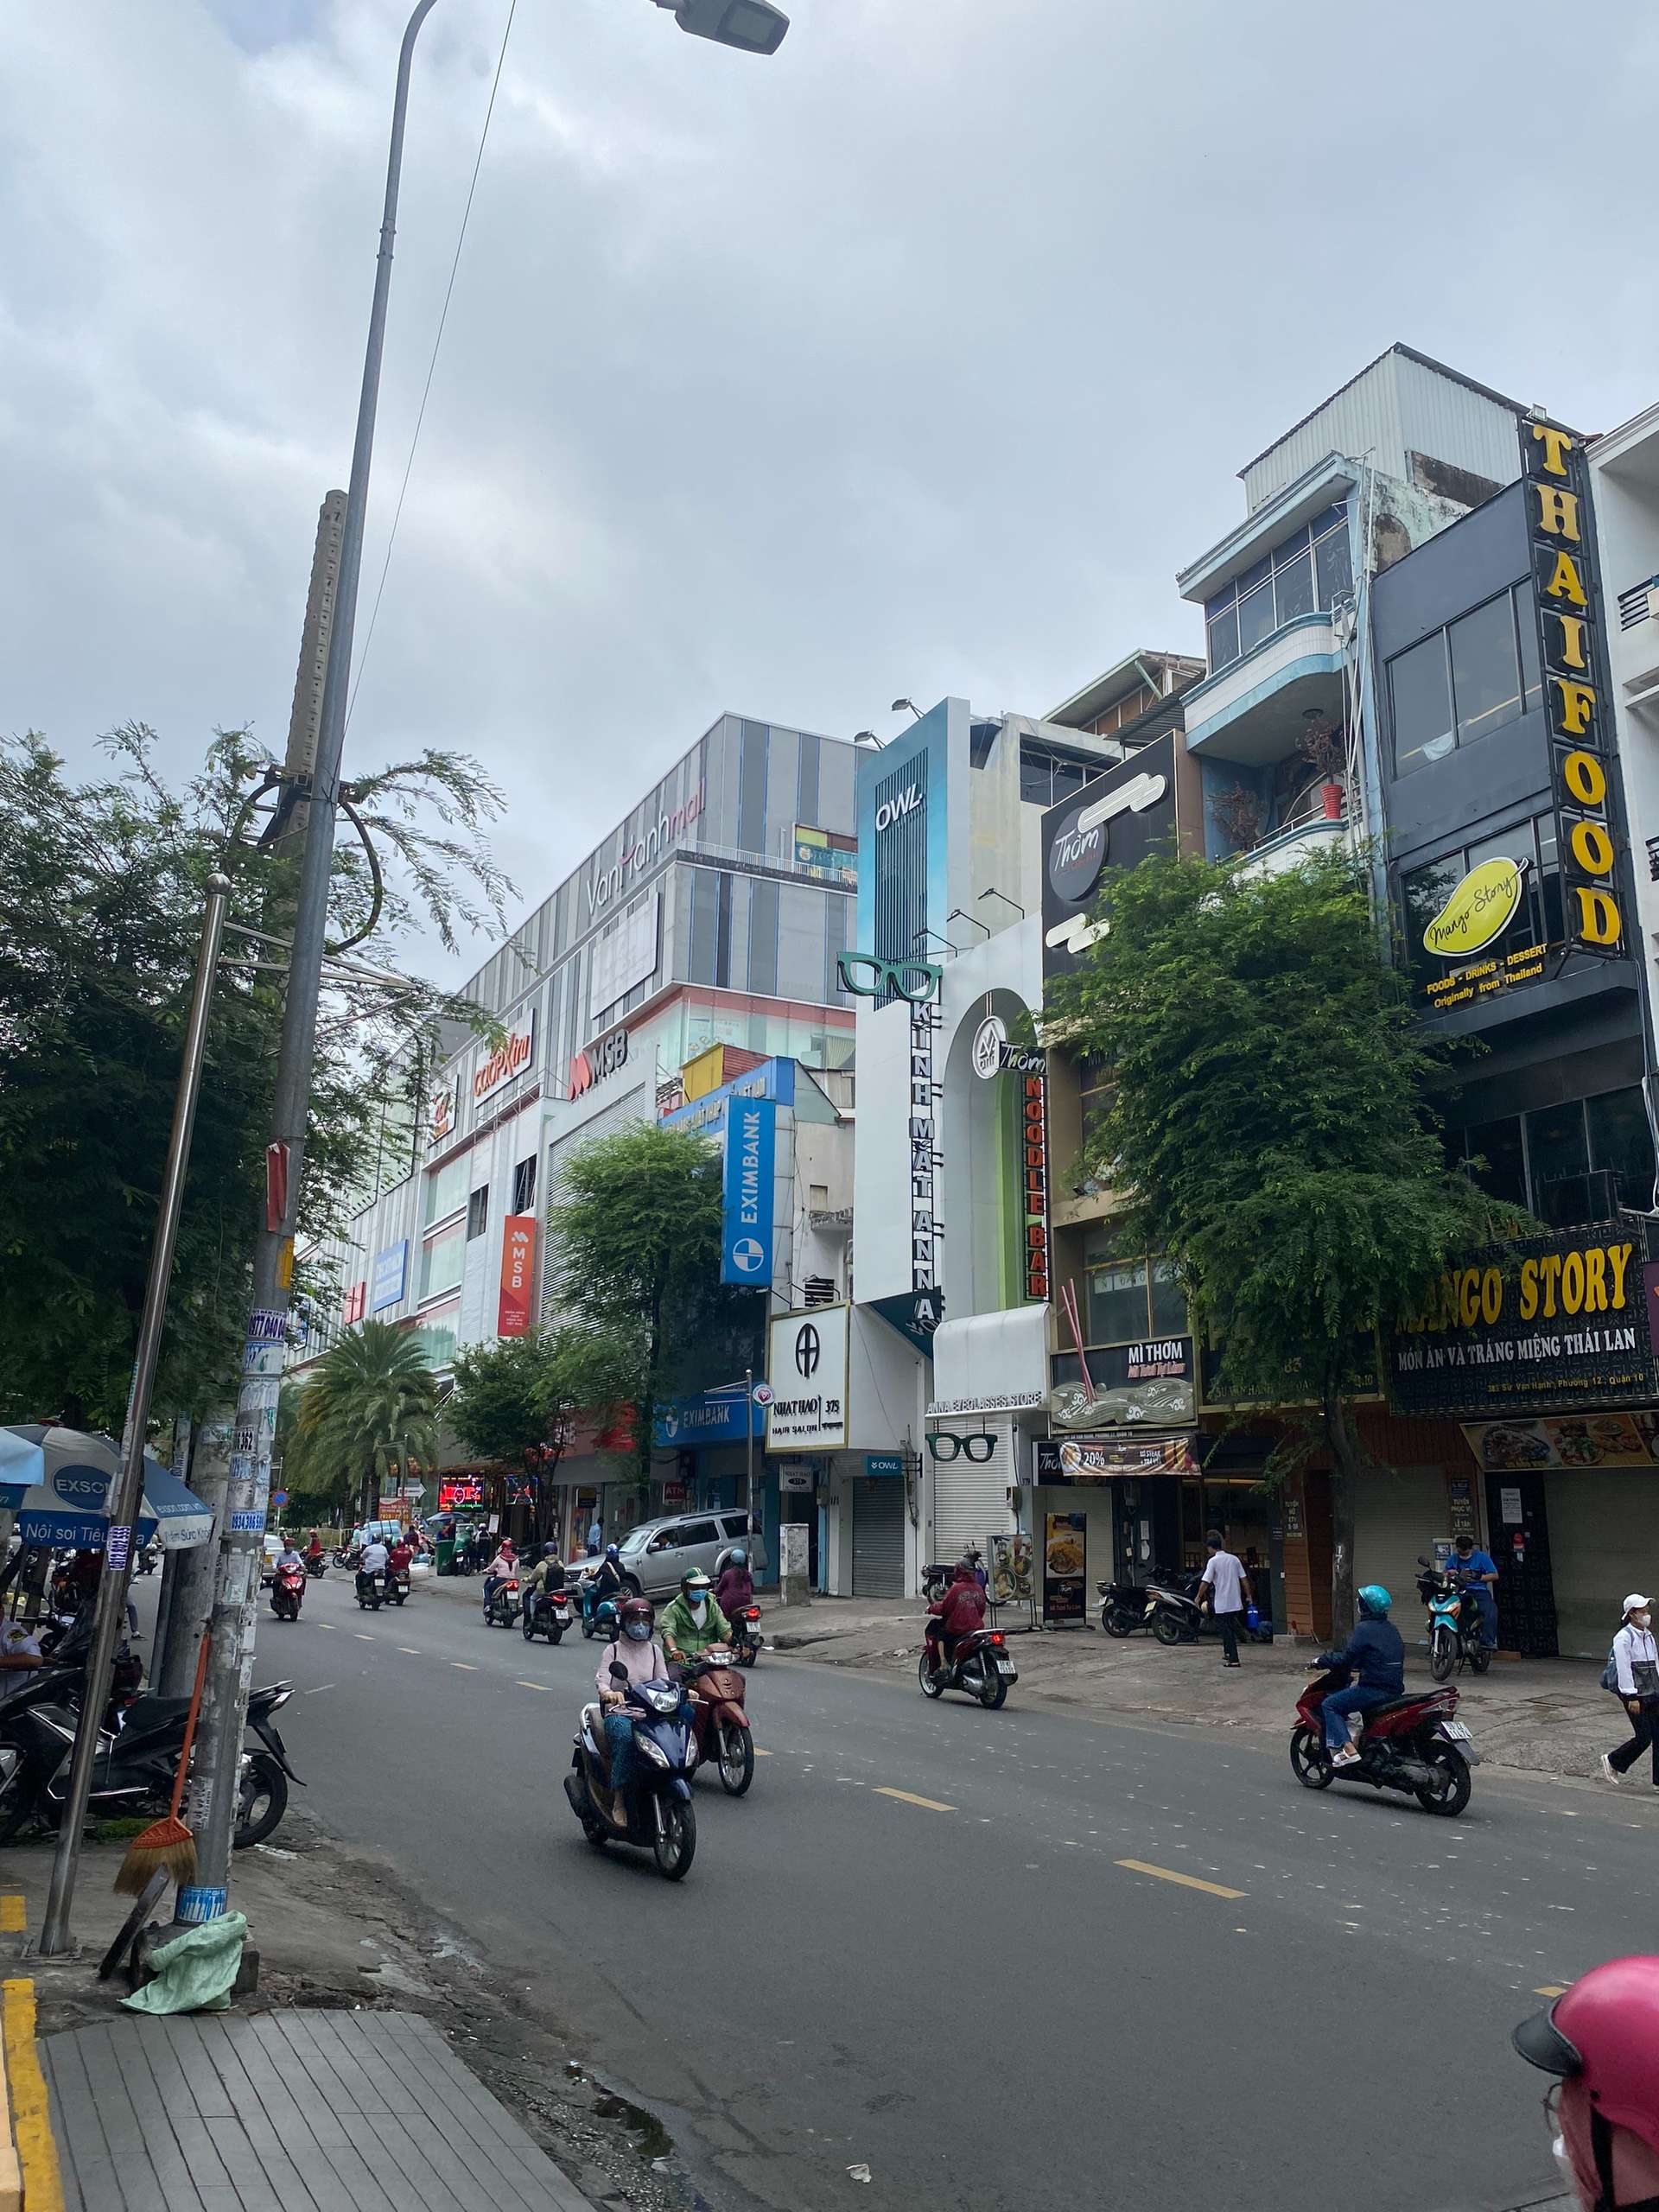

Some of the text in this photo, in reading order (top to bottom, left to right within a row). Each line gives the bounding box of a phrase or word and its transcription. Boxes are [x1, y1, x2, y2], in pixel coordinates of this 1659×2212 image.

[875, 783, 922, 831] OWL
[1429, 875, 1514, 945] Mango Story
[1427, 977, 1457, 995] FOODS
[1465, 963, 1497, 981] DRINKS
[1507, 944, 1548, 966] DESSERT
[1433, 963, 1543, 1008] Originally from Thailand
[591, 1028, 628, 1083] MSB
[741, 1111, 760, 1224] EXIMBANK
[1026, 1077, 1046, 1297] NOODLE BAR
[511, 1247, 526, 1288] MSB
[912, 1210, 934, 1319] ANNA
[1395, 1243, 1633, 1336] NGO STORY
[1128, 1341, 1183, 1363] MÌ THƠM
[1398, 1346, 1423, 1371] MÓN
[1446, 1342, 1465, 1367] VÀ
[1468, 1338, 1514, 1365] TRÁNG
[1517, 1332, 1560, 1363] MIỆNG
[1564, 1326, 1599, 1356] THÁI
[1605, 1327, 1636, 1351] LAN
[683, 1404, 730, 1428] EXIMBANK
[927, 1391, 1042, 1414] ANNA EYEGLASSES STORE
[772, 1426, 790, 1435] HAIR
[791, 1424, 817, 1434] SALON
[1083, 1452, 1105, 1466] 20%
[666, 1485, 685, 1495] ATM
[26, 1522, 108, 1542] Nội soi Tiêu
